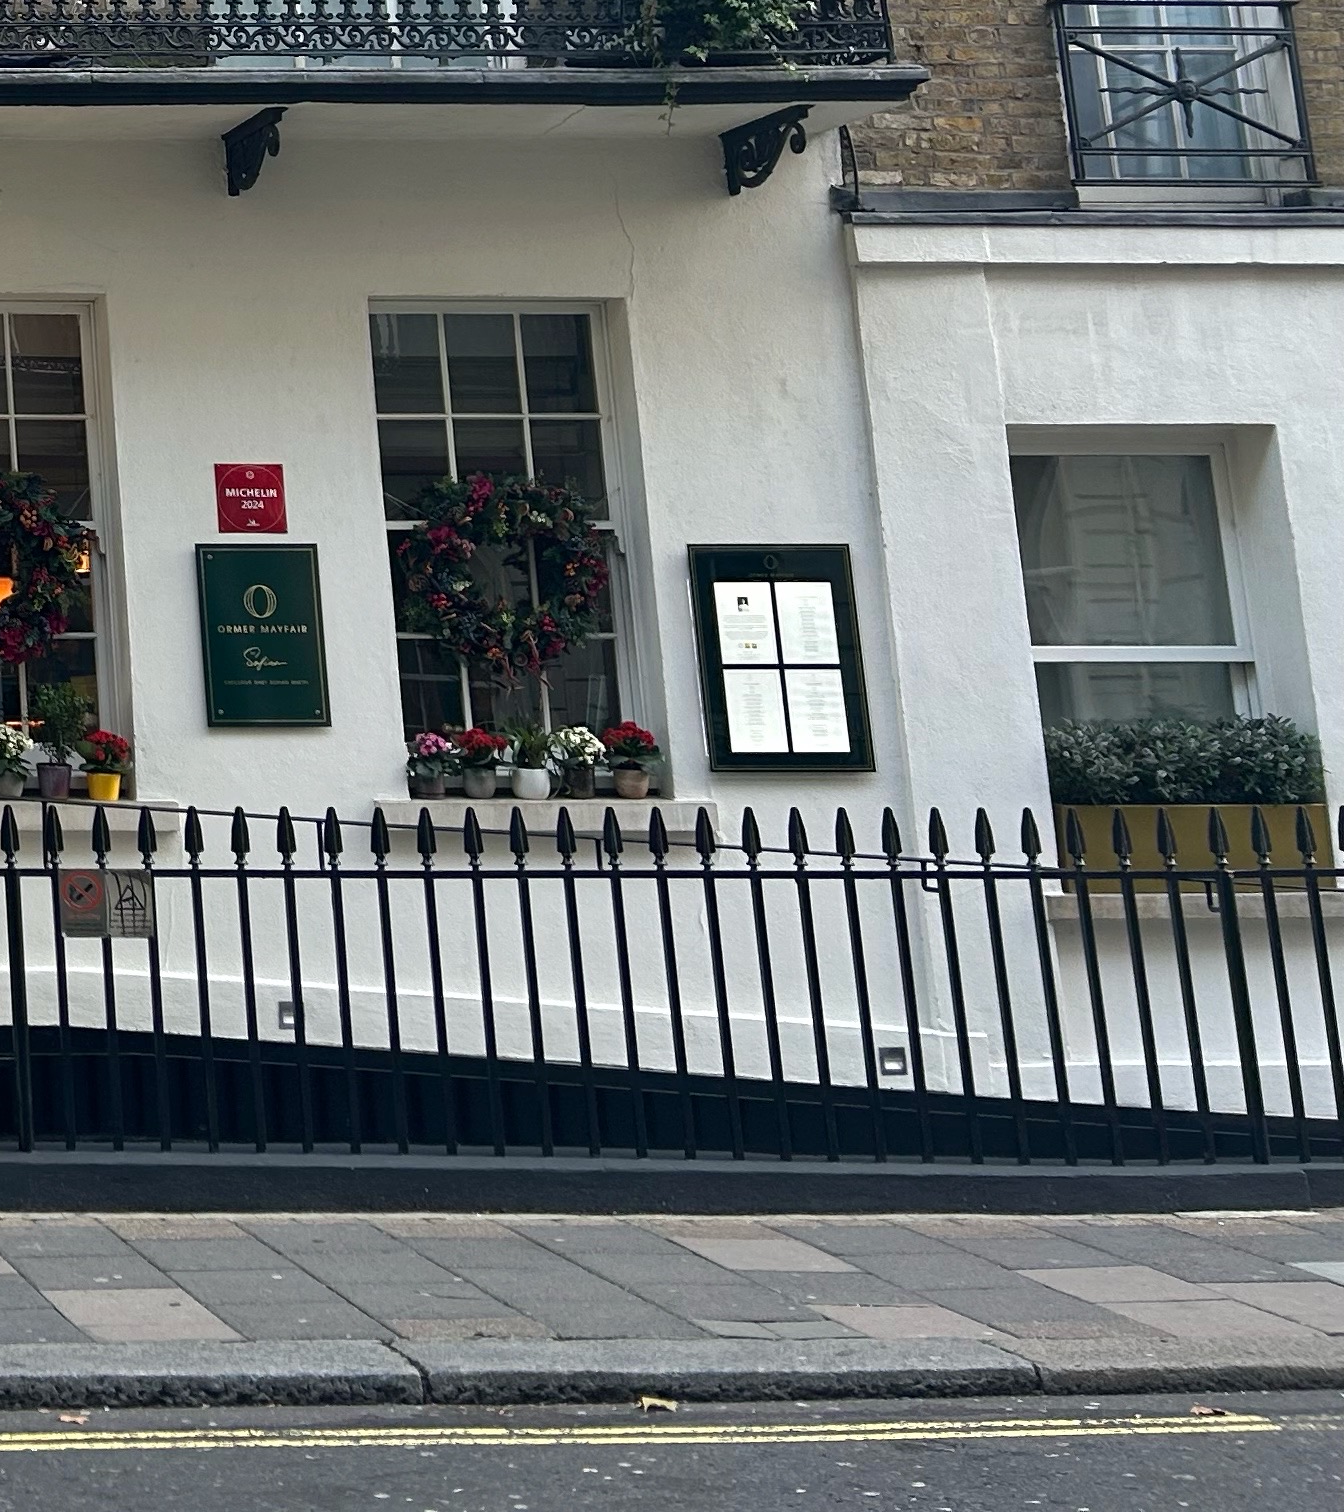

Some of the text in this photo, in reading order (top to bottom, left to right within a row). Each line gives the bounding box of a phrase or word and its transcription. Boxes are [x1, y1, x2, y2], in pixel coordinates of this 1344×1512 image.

[225, 488, 278, 498] MICHELIN
[240, 500, 265, 510] 2024
[217, 625, 309, 634] ORMER MAYFAIR
